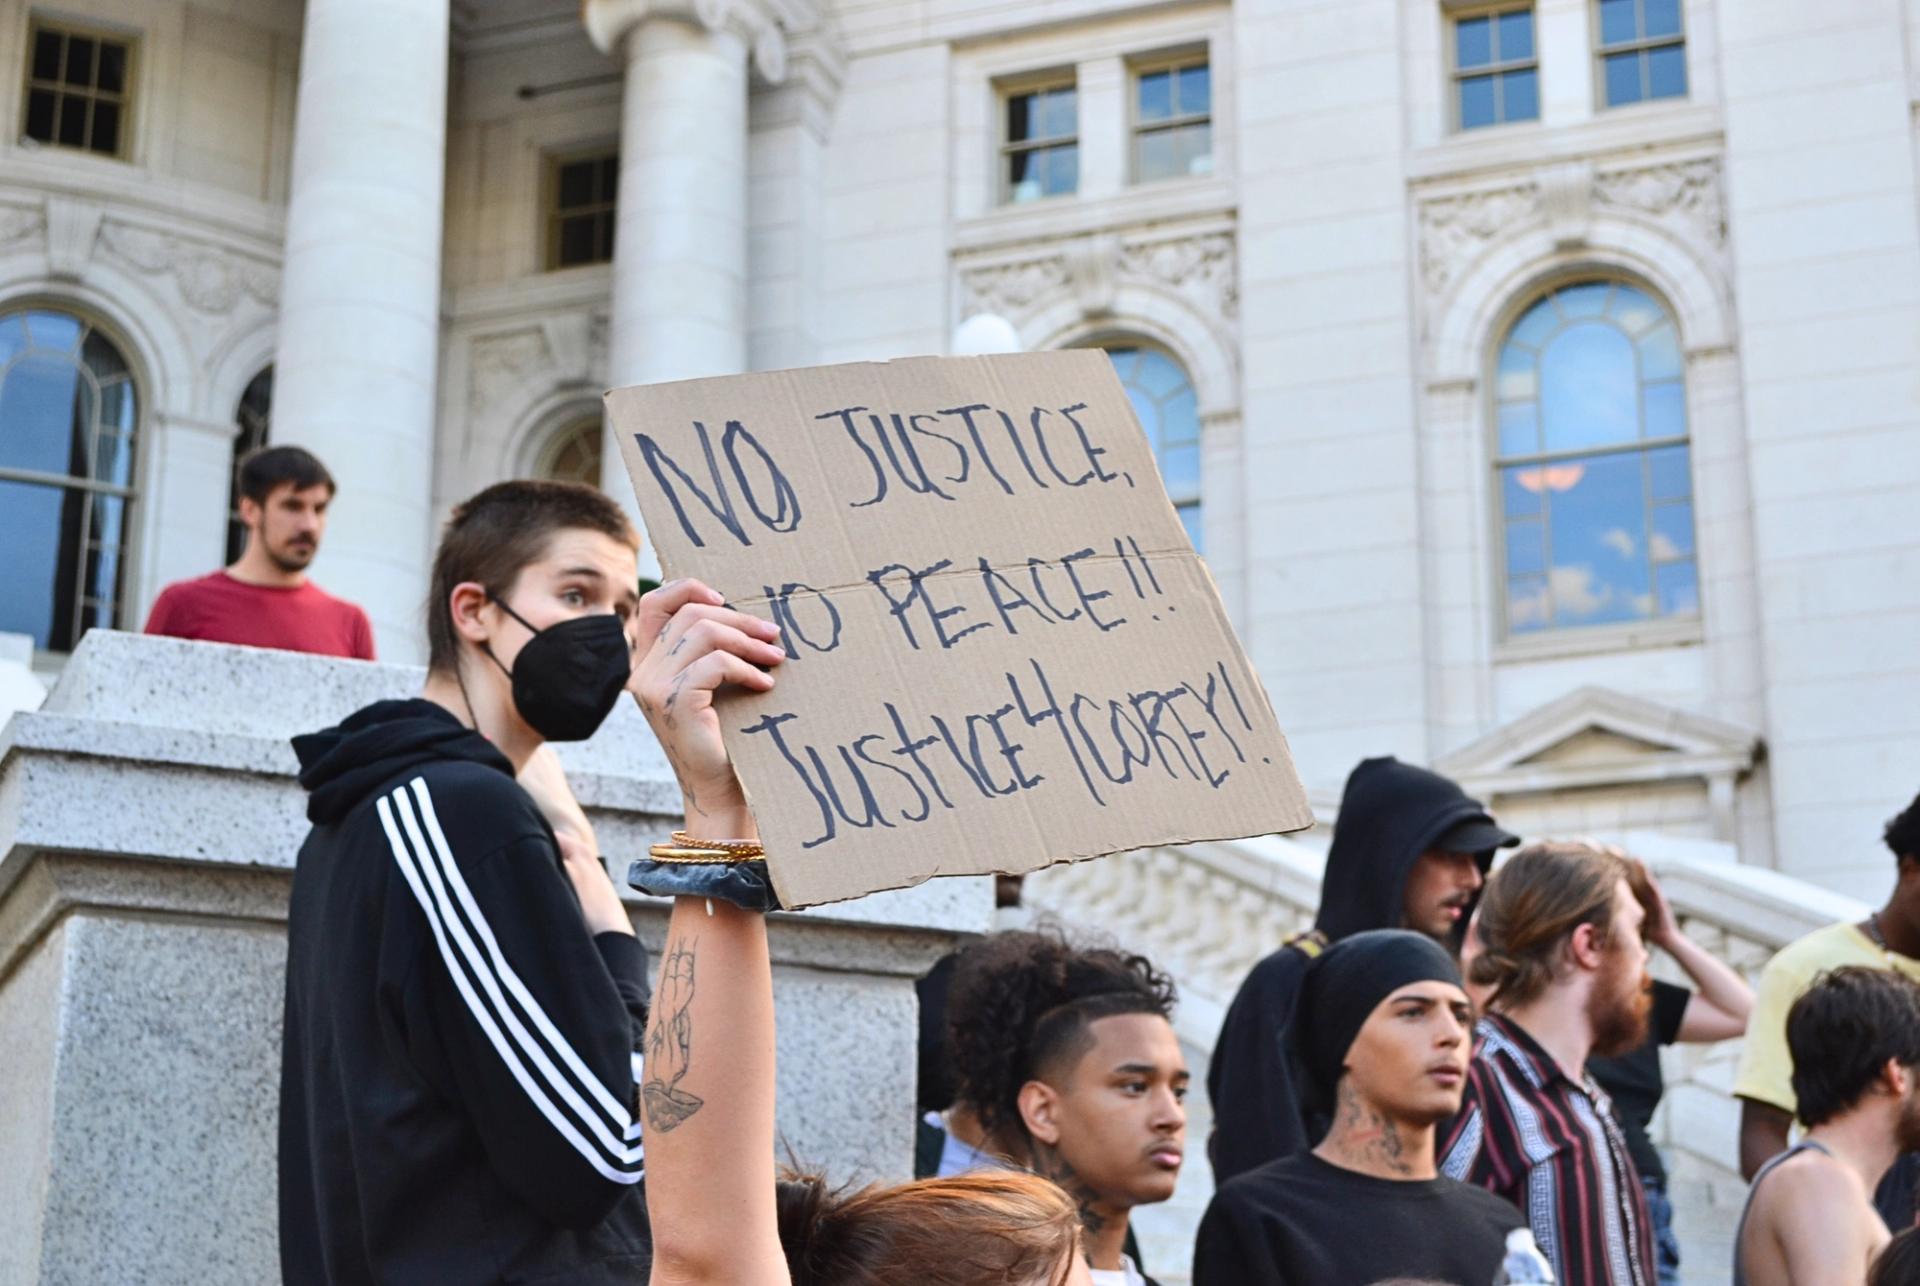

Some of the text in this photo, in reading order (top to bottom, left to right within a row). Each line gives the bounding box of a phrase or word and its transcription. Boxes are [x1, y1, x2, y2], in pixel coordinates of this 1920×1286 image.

[634, 402, 1135, 548] NO JUSTICE,
[866, 536, 1178, 650] PEACE!!
